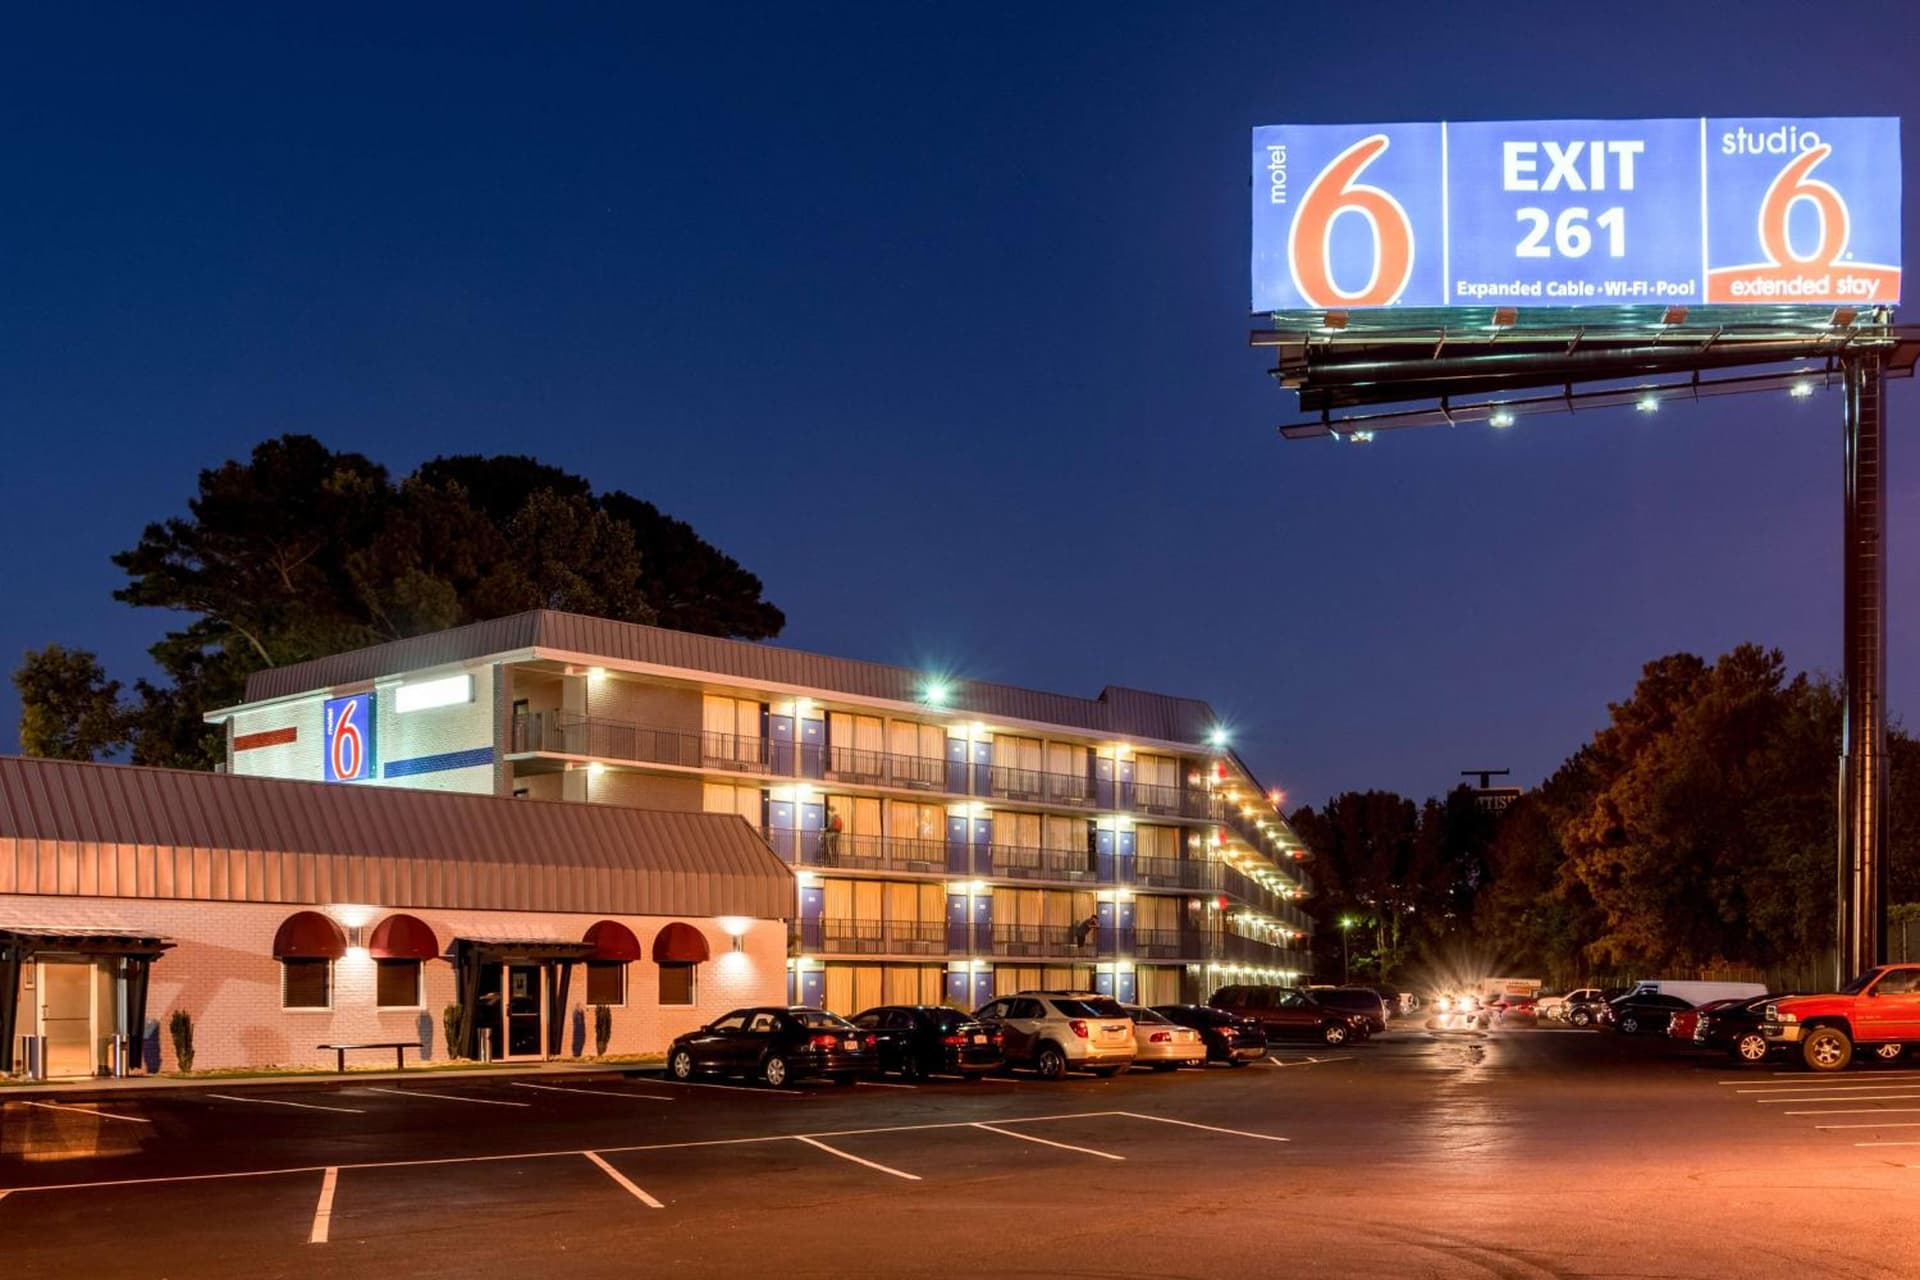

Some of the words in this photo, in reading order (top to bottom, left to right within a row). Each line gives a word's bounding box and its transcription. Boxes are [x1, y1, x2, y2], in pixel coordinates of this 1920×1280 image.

[1503, 140, 1645, 191] EXIT
[1721, 126, 1820, 154] studio
[1267, 145, 1286, 204] motel
[1288, 134, 1415, 307] 6
[1758, 143, 1850, 267] 6
[1515, 206, 1625, 258] 261
[1456, 280, 1542, 298] Expanded
[1546, 280, 1594, 296] Cable
[1656, 279, 1695, 296] Pool
[1730, 273, 1830, 296] extended
[1836, 273, 1880, 299] stay
[332, 700, 362, 779] 6
